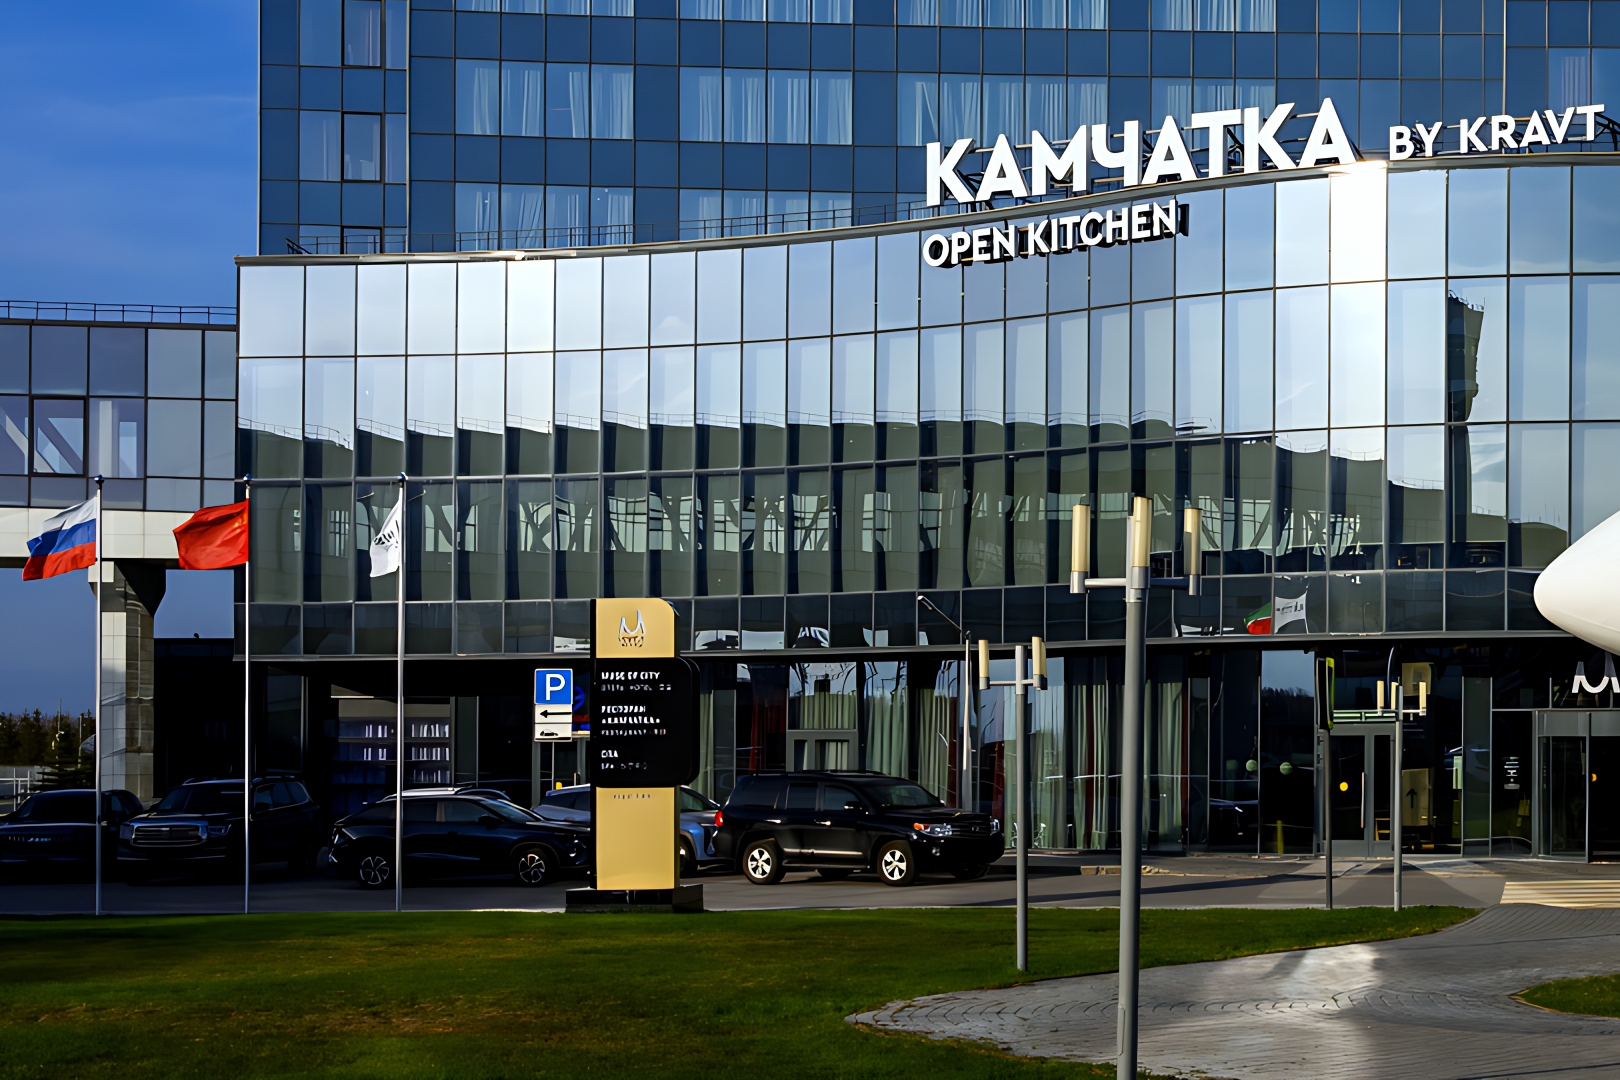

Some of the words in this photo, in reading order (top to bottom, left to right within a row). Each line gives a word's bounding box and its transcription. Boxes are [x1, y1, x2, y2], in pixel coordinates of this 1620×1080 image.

[926, 96, 1358, 207] КАМЧАТКА
[1389, 121, 1444, 161] BY
[1457, 103, 1606, 154] KRAVT
[922, 223, 1016, 268] OPEN
[1027, 198, 1177, 255] KITCHEN
[545, 673, 566, 701] P
